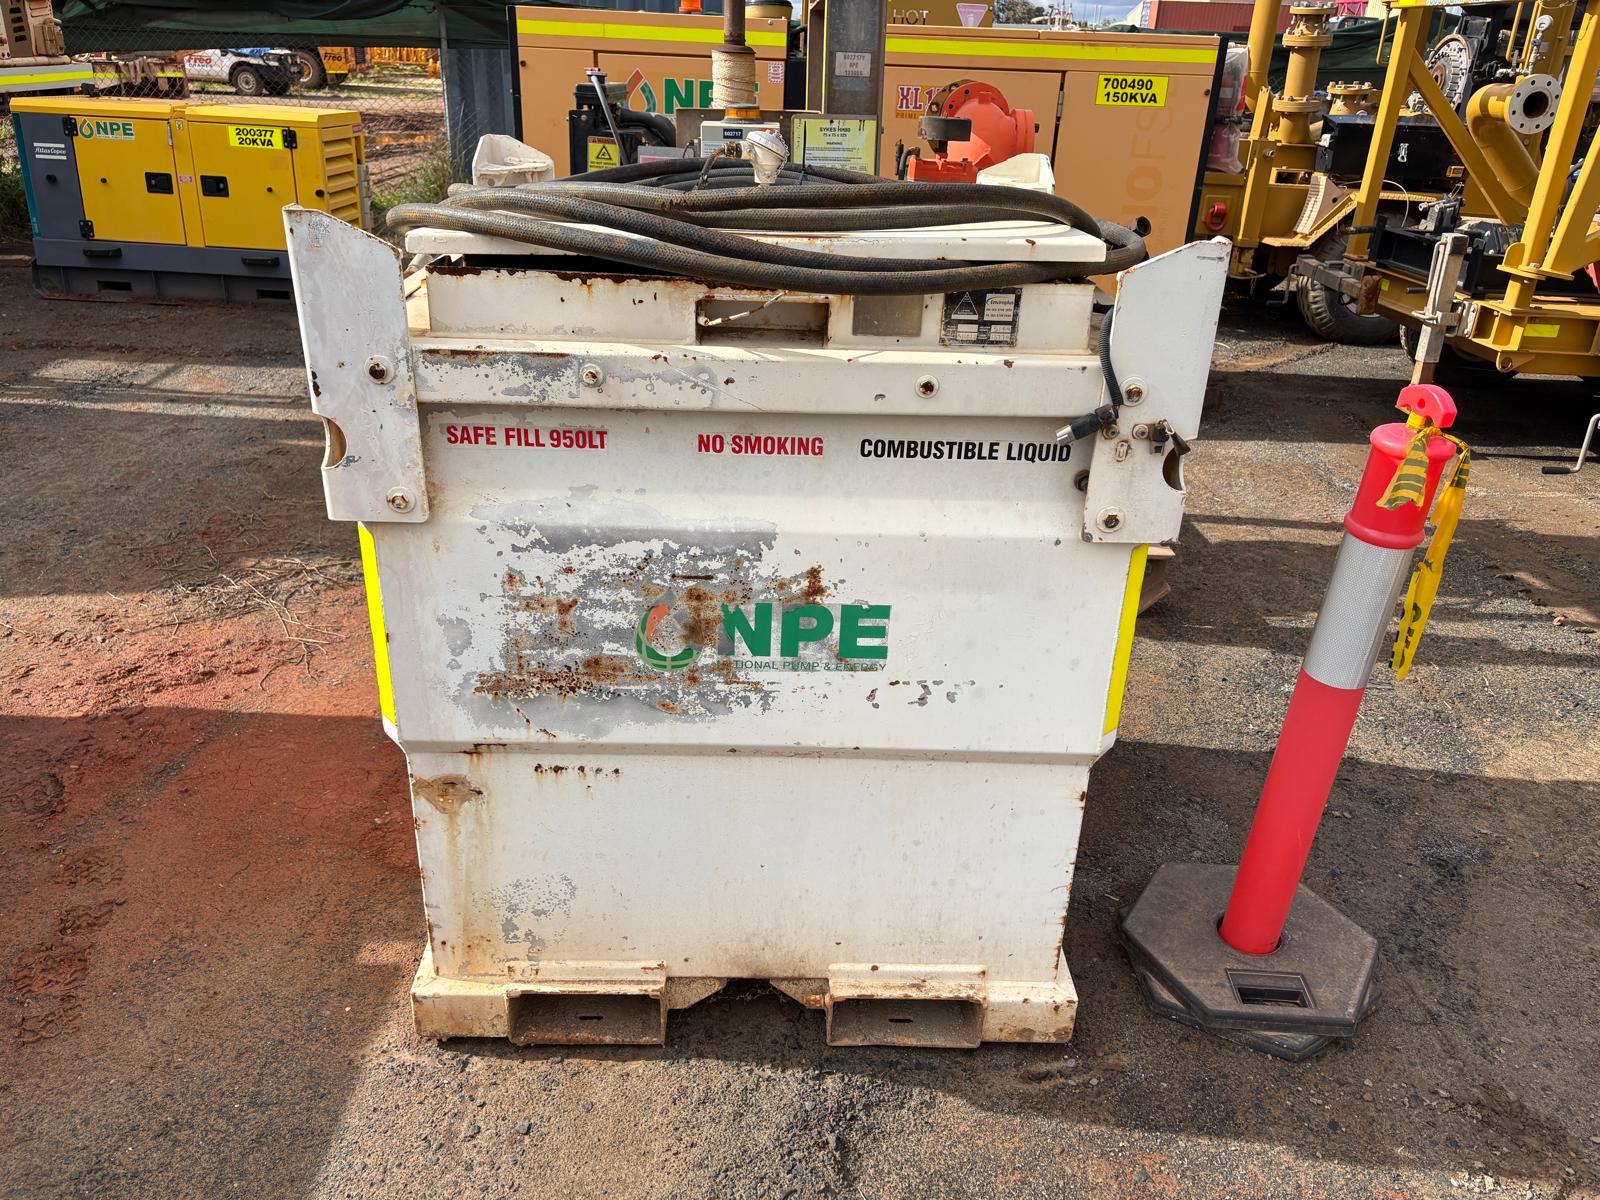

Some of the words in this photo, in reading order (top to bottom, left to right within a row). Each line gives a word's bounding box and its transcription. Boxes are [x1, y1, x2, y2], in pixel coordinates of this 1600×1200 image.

[893, 8, 929, 25] HOT
[187, 54, 212, 64] Freo
[324, 53, 343, 61] Freo
[1103, 77, 1153, 90] 700490
[1104, 91, 1158, 104] 150KVA
[95, 121, 134, 137] NPE
[235, 127, 275, 138] 200377
[237, 137, 274, 148] 20KVA
[446, 425, 498, 446] SAFE
[504, 427, 546, 448] FILL
[549, 428, 608, 450] 950LT
[697, 434, 725, 454] NO
[731, 435, 824, 456] SMOKING
[859, 438, 999, 461] COMBUSTIBLE
[1006, 442, 1072, 464] LIQUID
[719, 602, 892, 660] NPE
[782, 660, 820, 671] PUMP
[823, 662, 832, 671] &
